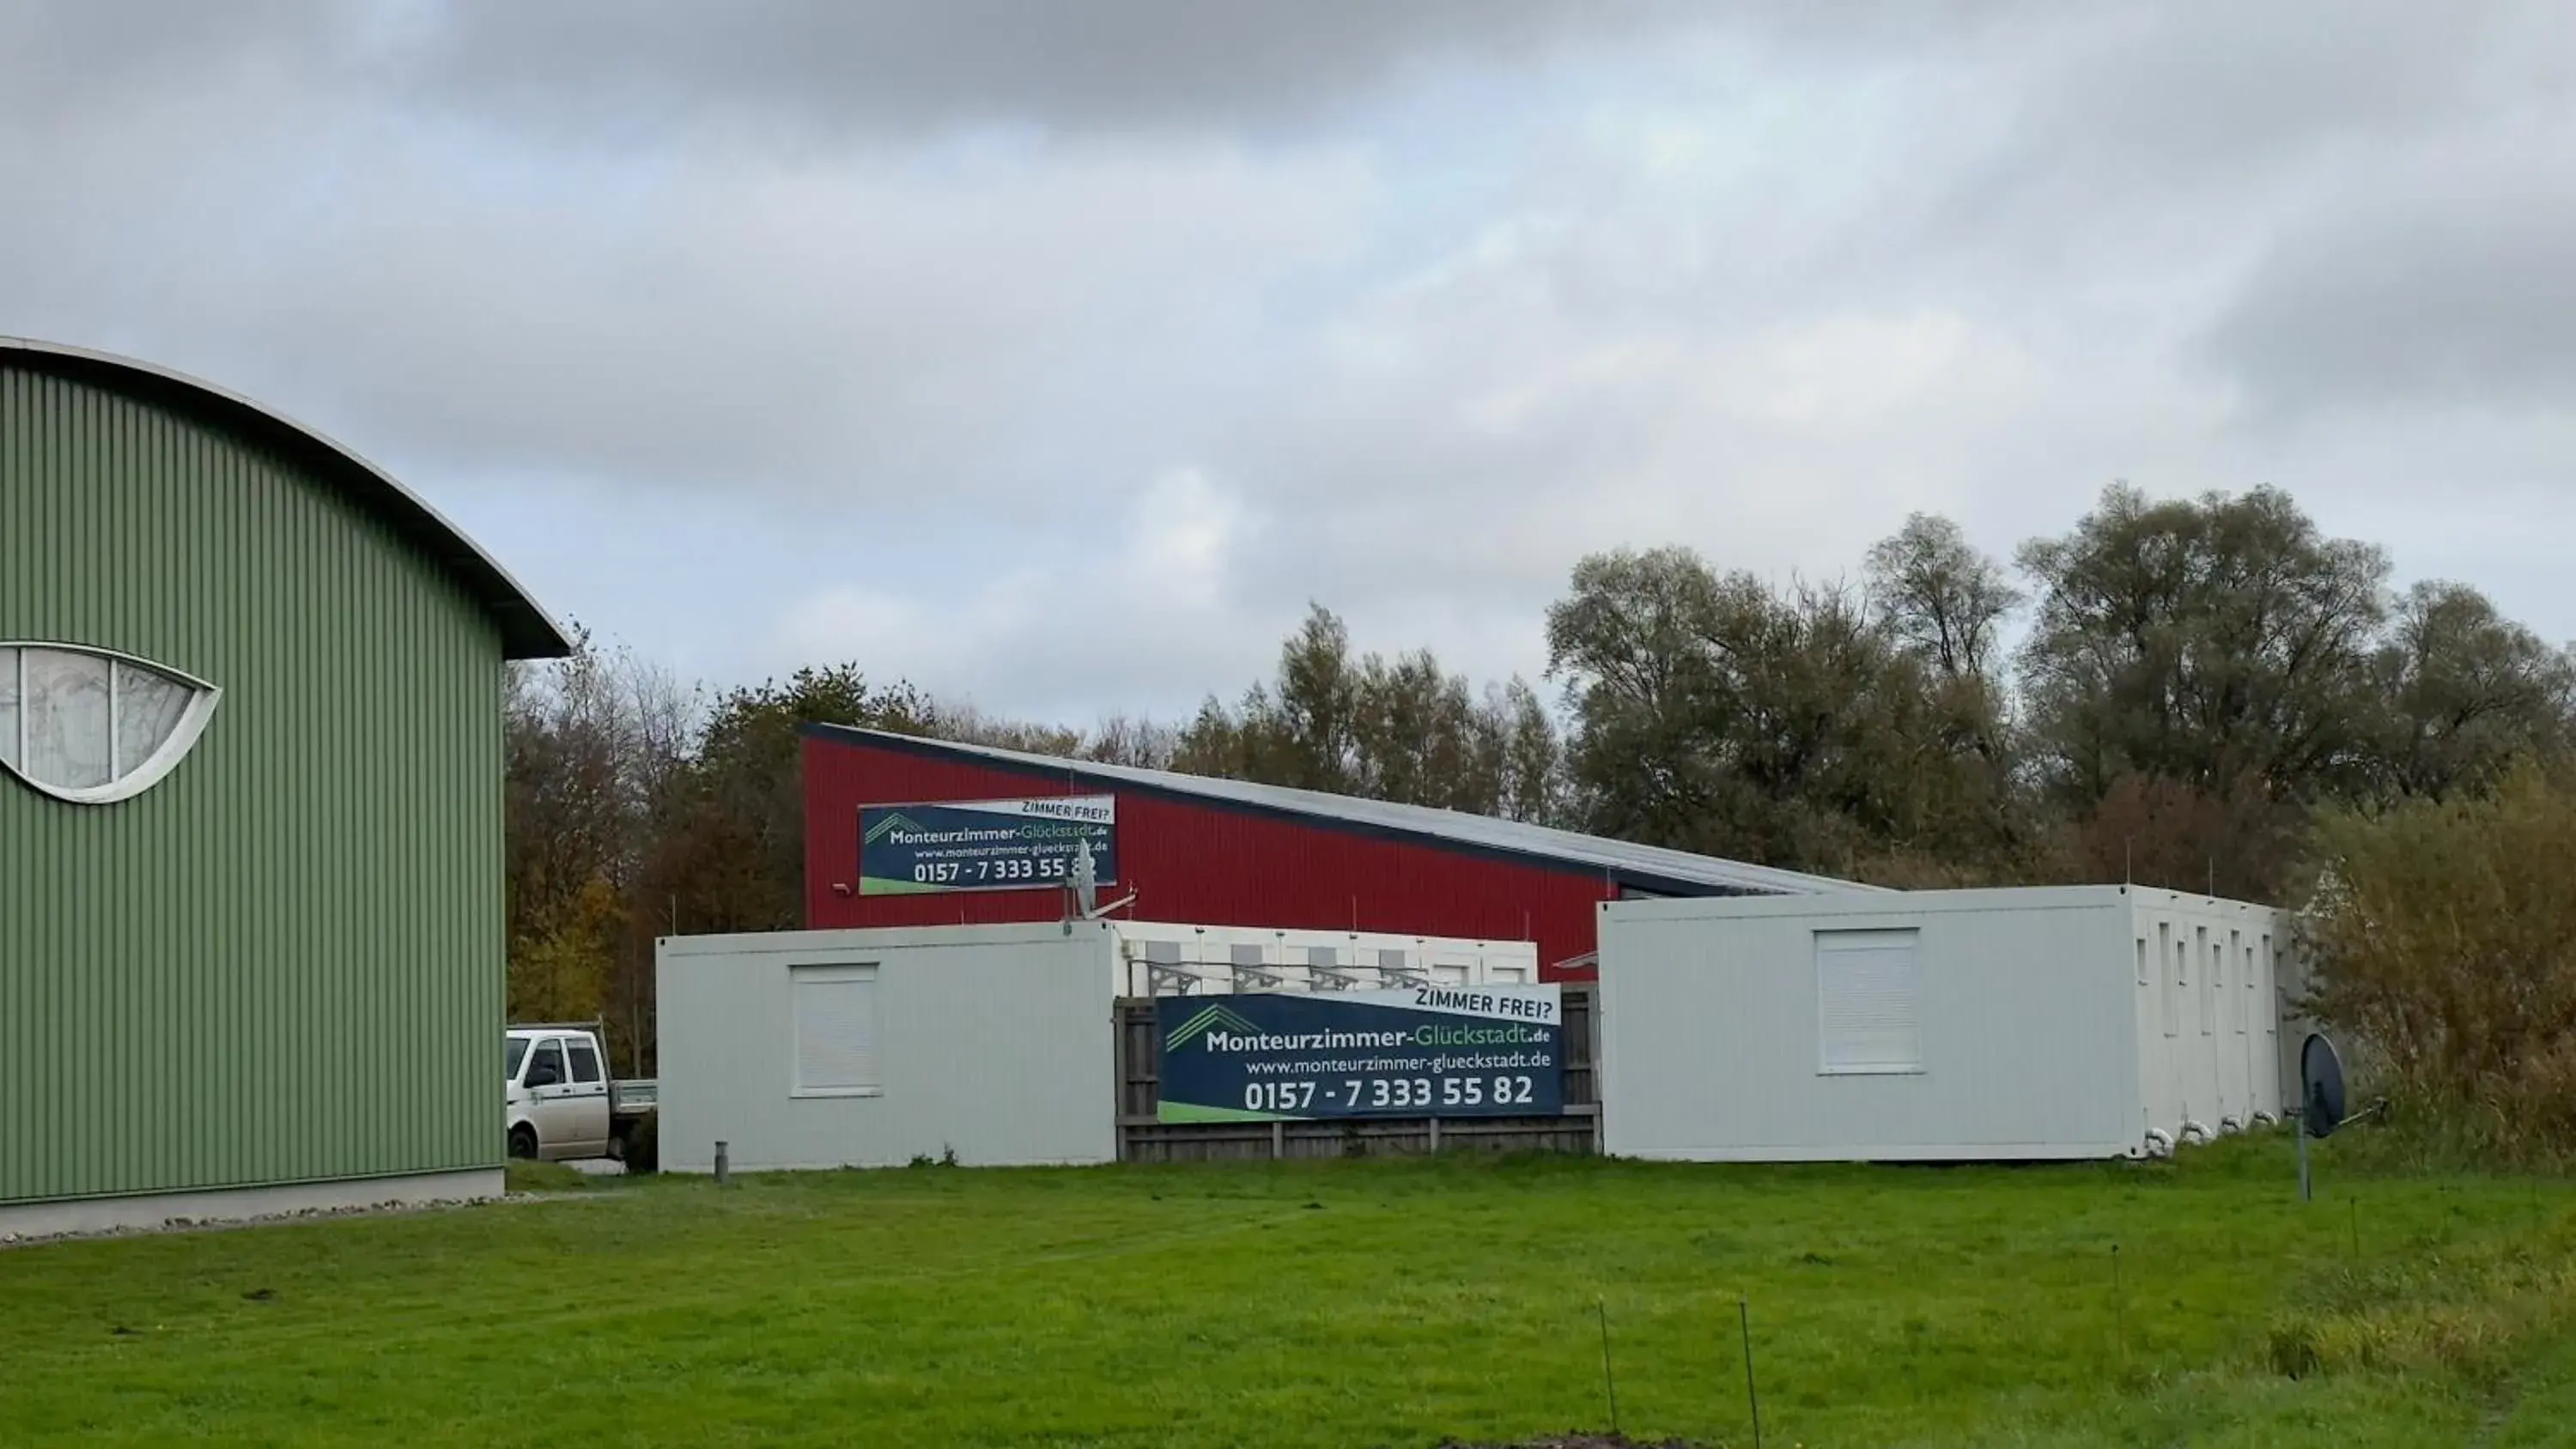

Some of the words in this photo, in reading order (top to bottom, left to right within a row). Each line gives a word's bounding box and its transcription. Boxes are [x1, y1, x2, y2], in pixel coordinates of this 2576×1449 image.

[1022, 801, 1072, 816] ZIMMER
[1074, 806, 1109, 821] FREI?
[914, 863, 959, 882] 0157
[977, 861, 988, 880] 7
[994, 859, 1033, 879] 333
[1039, 858, 1064, 876] 55
[1415, 988, 1492, 1012] ZIMMER
[1499, 997, 1552, 1019] FREI?
[1206, 1023, 1551, 1052] Monteurzimmer-Glückstadt.de
[1246, 1051, 1551, 1074] www.monteurzimmer-glueckstadt.de
[1245, 1081, 1316, 1110] 0157
[1346, 1080, 1362, 1107] 7
[1372, 1078, 1431, 1106] 333
[1443, 1077, 1483, 1106] 55
[1493, 1076, 1533, 1104] 82
